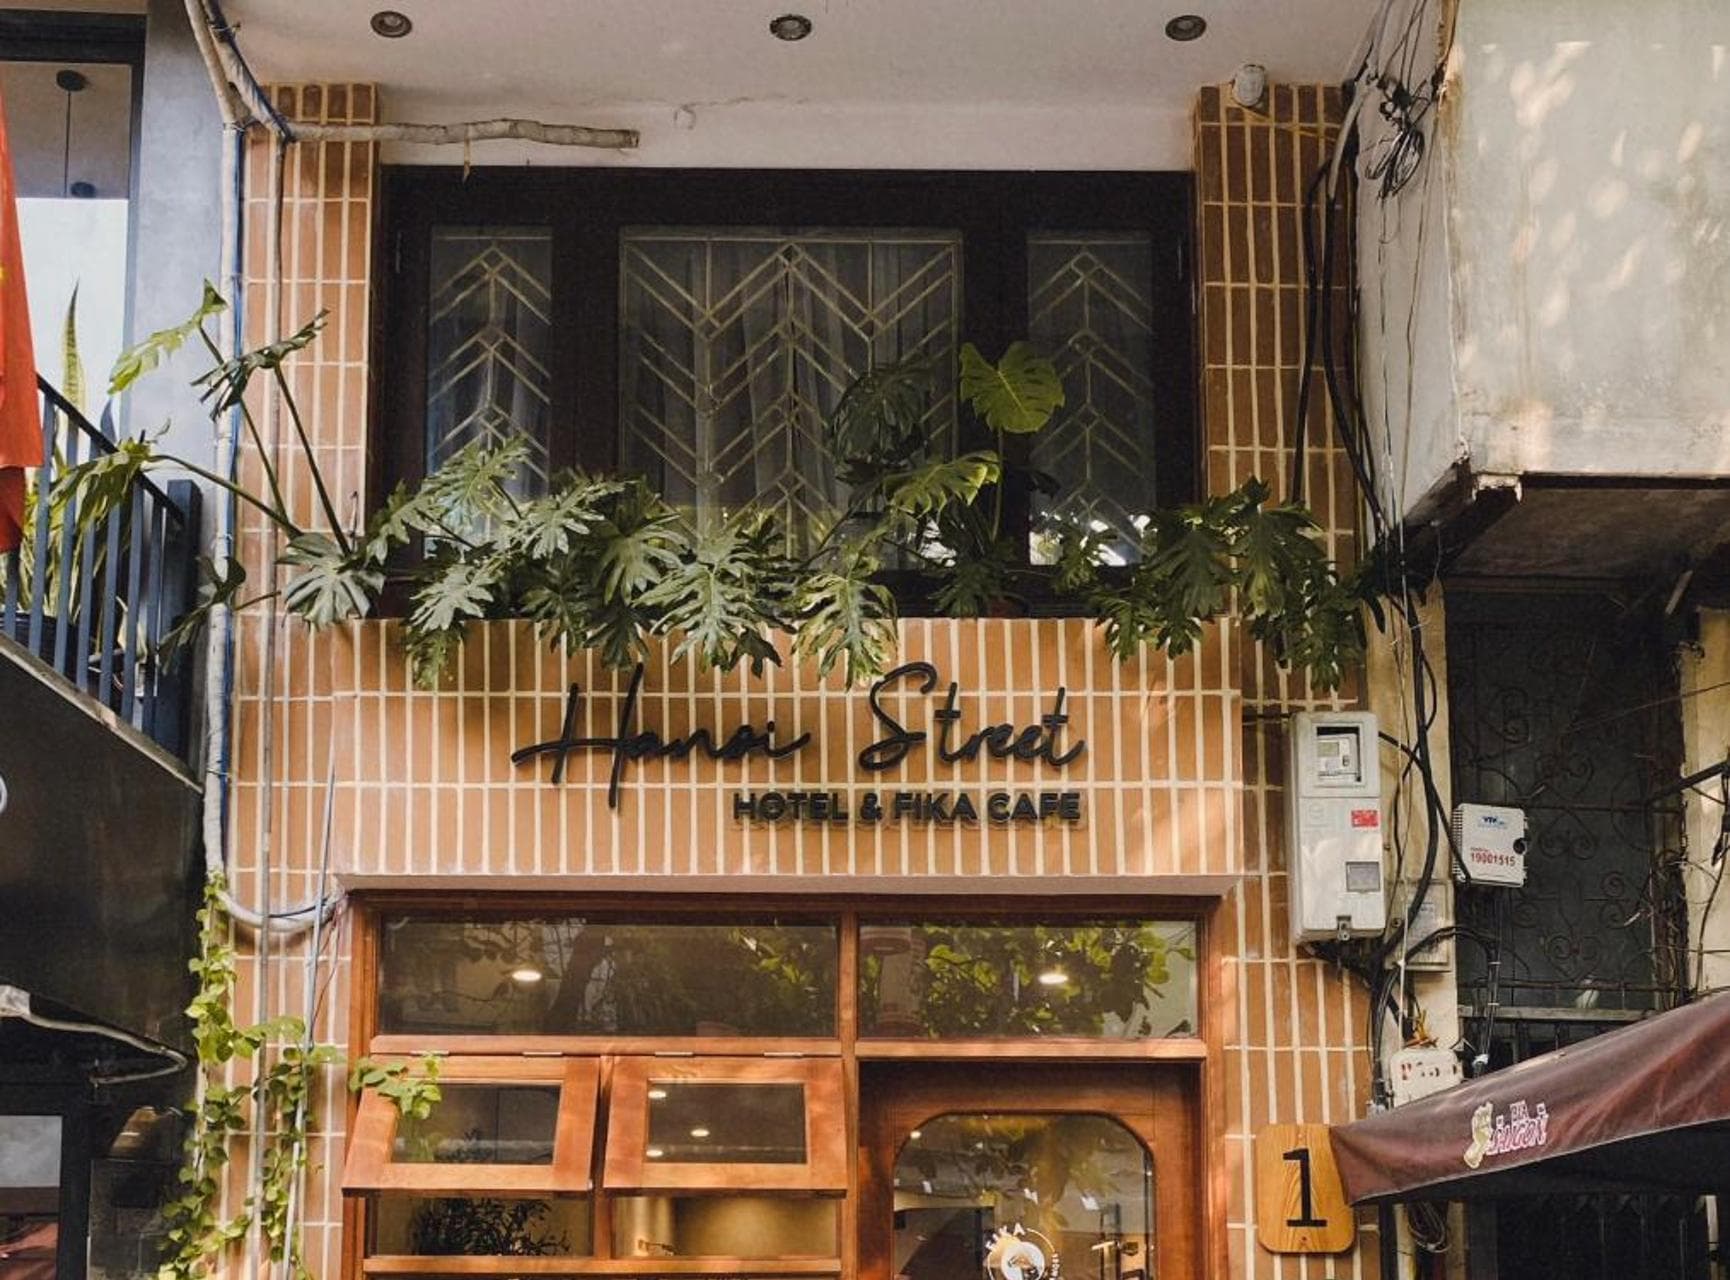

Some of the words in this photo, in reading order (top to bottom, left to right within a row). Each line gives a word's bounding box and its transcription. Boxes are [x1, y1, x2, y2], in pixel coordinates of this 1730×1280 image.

[511, 662, 811, 809] Hanoi
[859, 661, 1087, 771] Street
[733, 791, 848, 821] HOTEL
[861, 791, 882, 821] &
[895, 791, 977, 821] FIKA
[988, 791, 1080, 821] CAFE
[1283, 1148, 1327, 1227] 1
